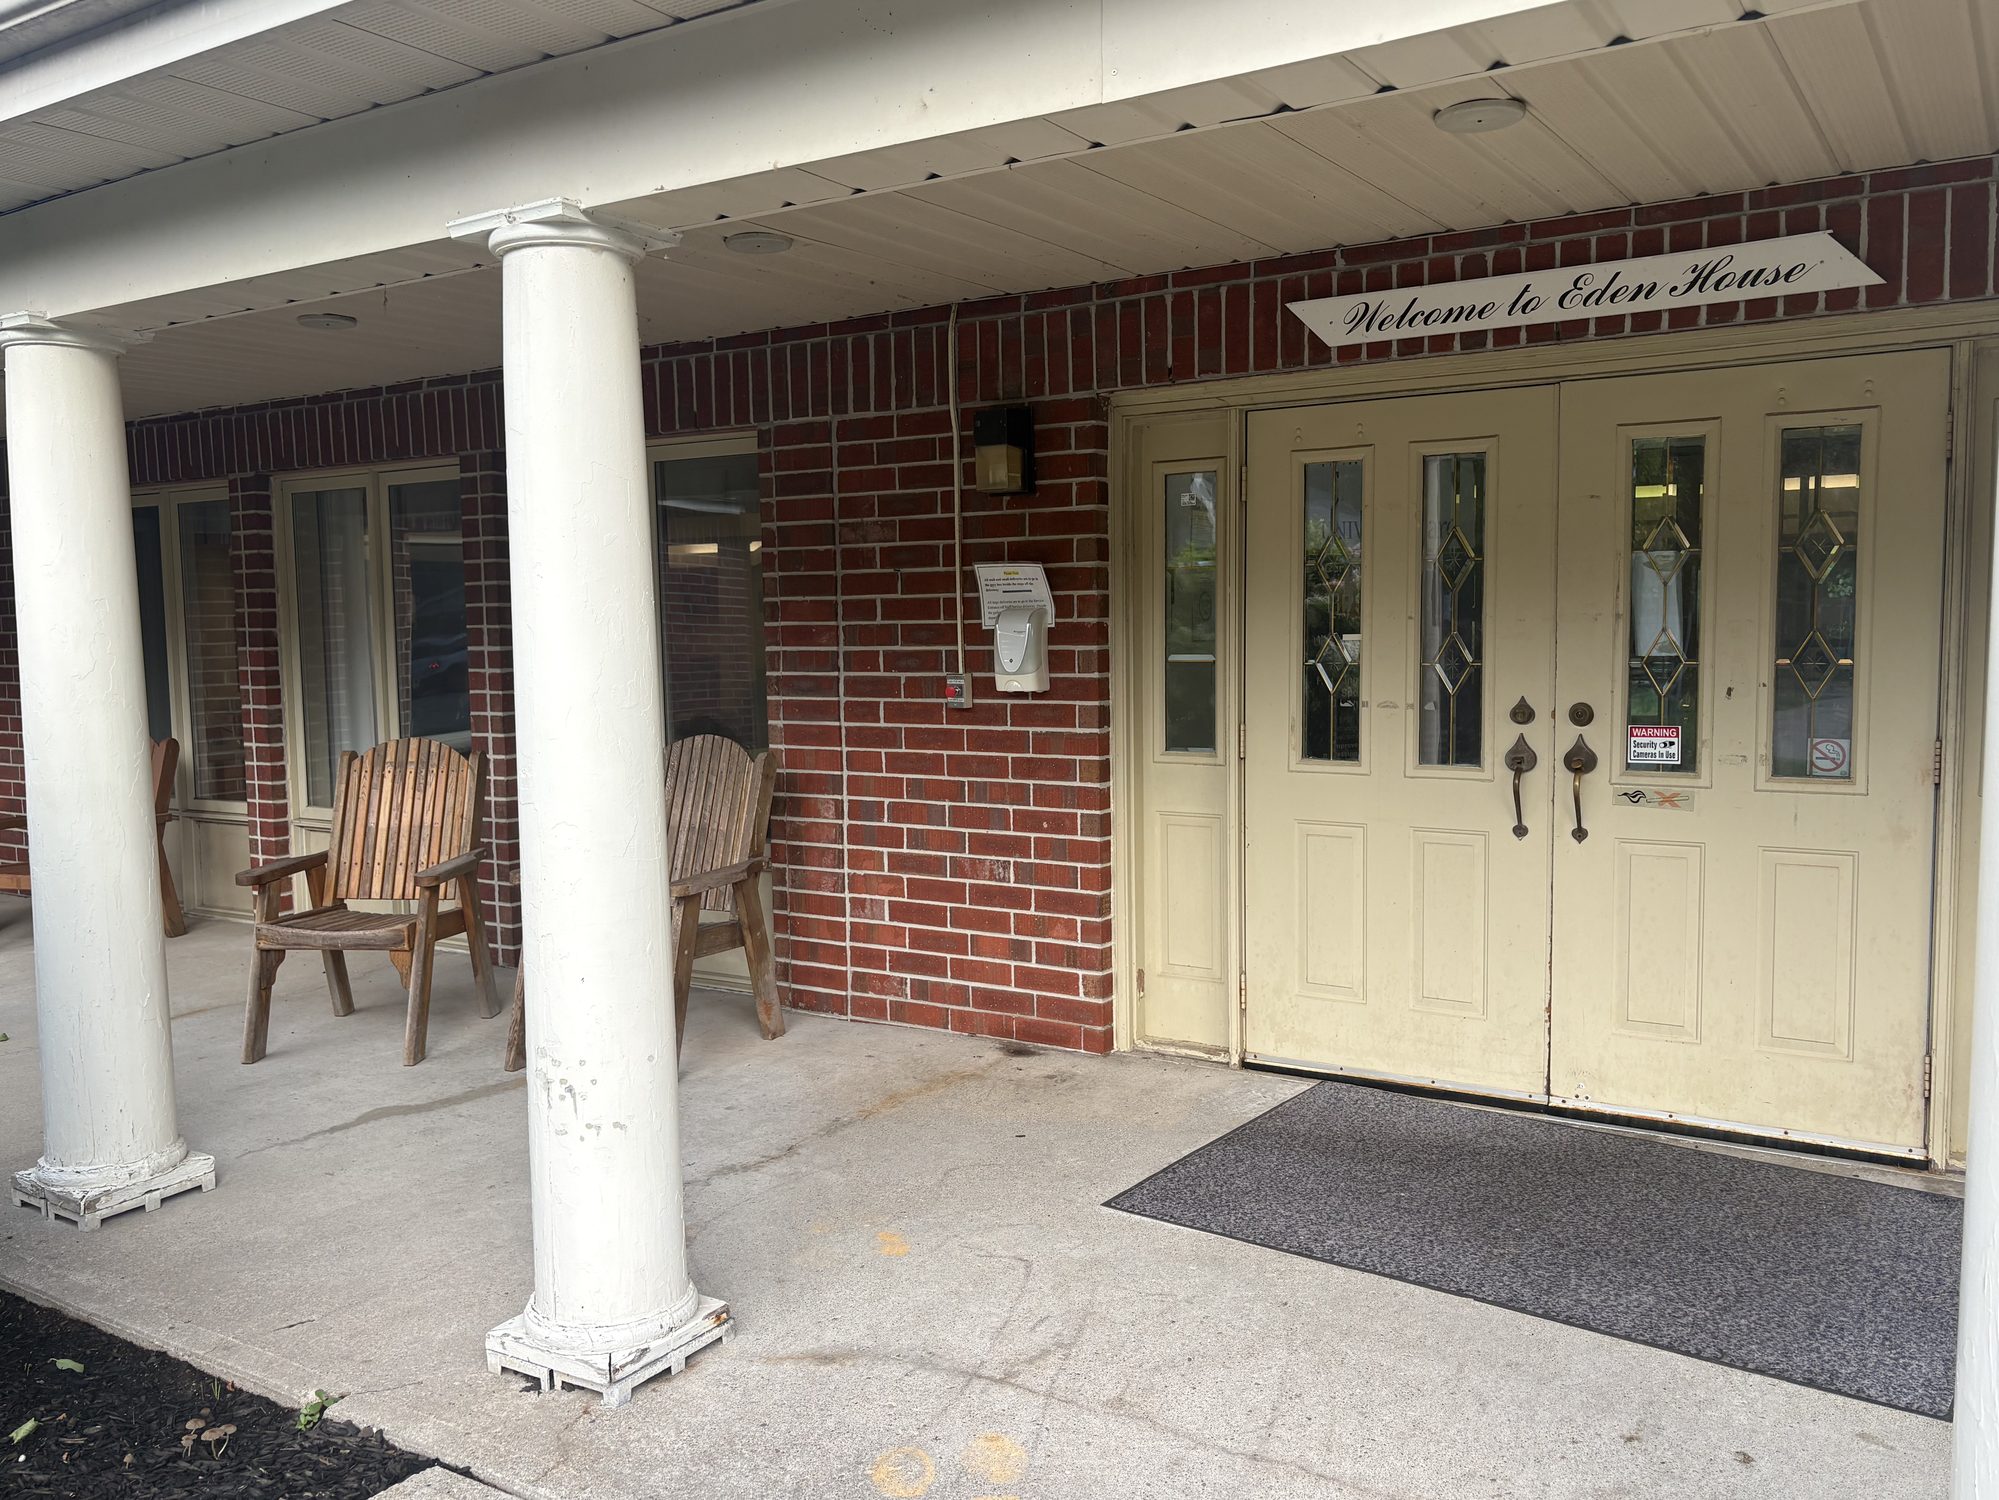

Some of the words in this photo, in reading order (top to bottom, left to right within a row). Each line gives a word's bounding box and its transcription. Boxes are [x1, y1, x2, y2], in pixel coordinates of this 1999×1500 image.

[1343, 296, 1504, 336] Welcome
[1506, 283, 1550, 317] to
[1557, 270, 1669, 310] Eden
[1669, 254, 1817, 298] House
[1632, 728, 1677, 737] WARNING
[1633, 740, 1657, 750] Security
[1633, 750, 1657, 759] Cameras
[1658, 750, 1664, 758] In
[1666, 750, 1676, 759] Use
